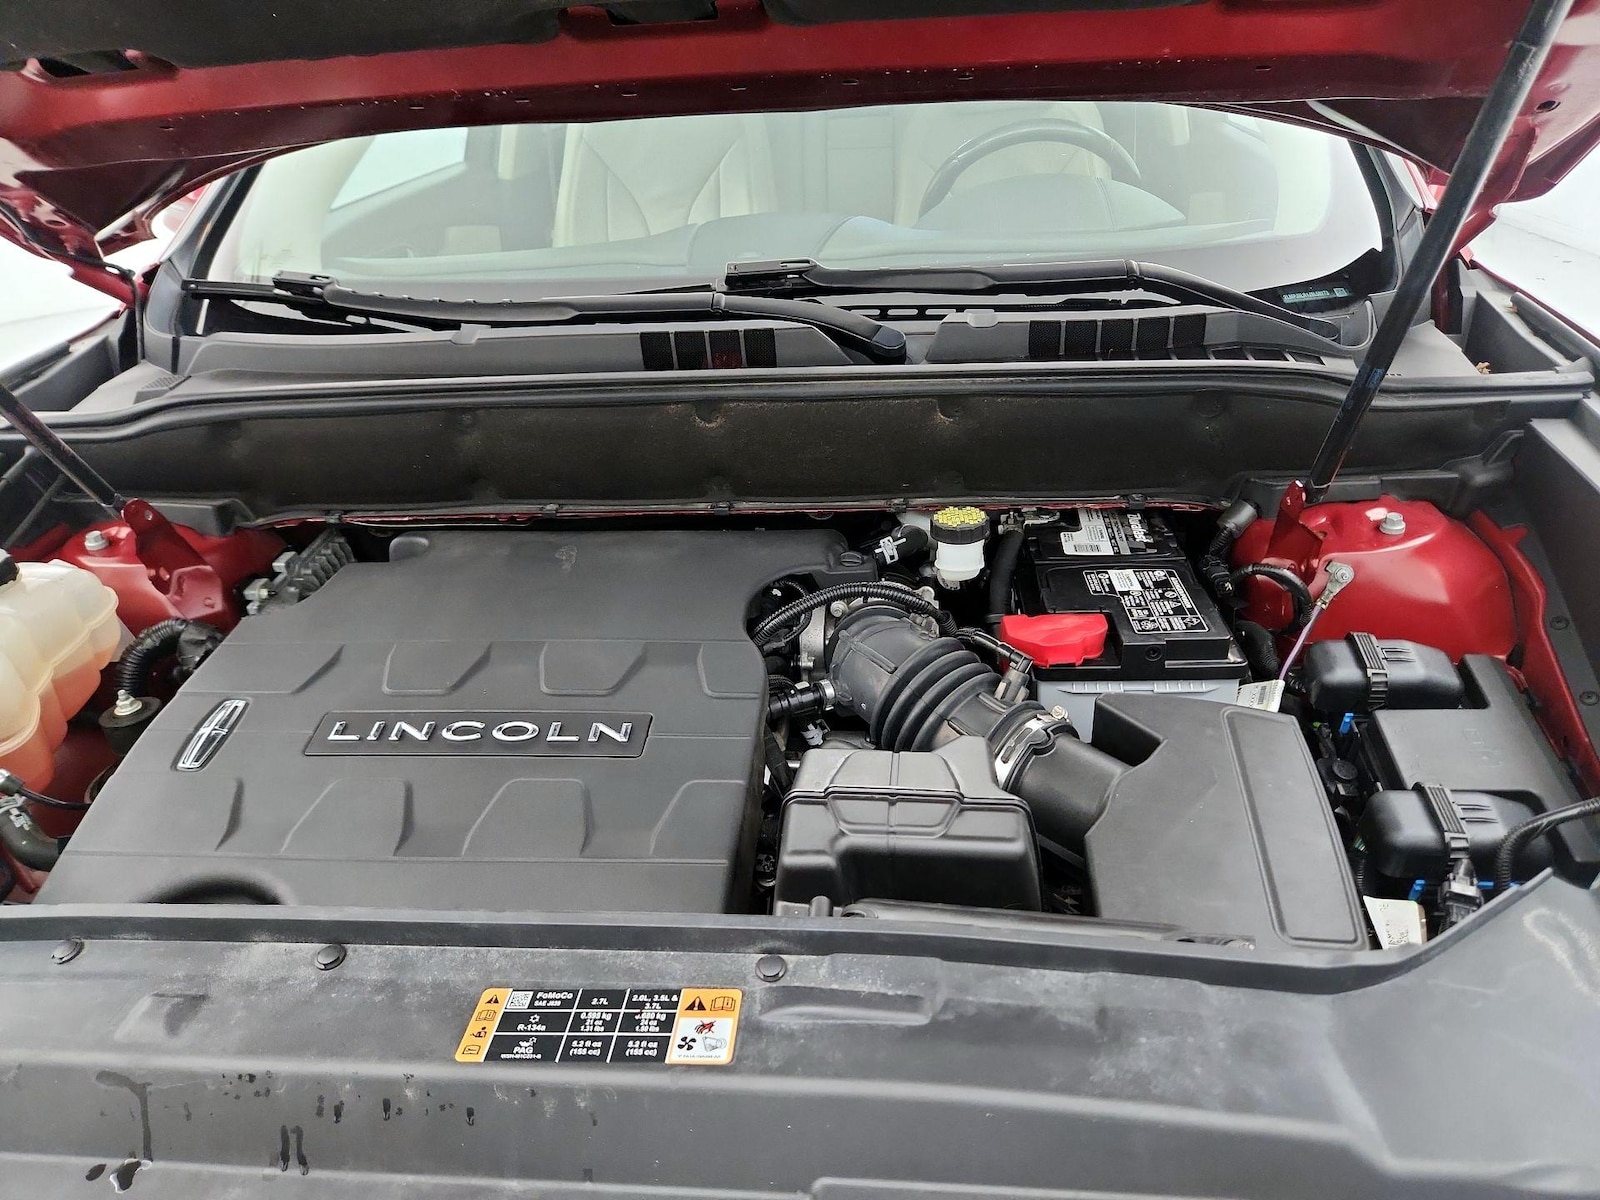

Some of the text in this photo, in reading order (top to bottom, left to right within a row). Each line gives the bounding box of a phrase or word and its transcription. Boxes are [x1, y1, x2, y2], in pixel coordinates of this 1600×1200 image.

[1127, 513, 1154, 543] Duralast
[327, 721, 632, 742] LINCOLN
[601, 1011, 612, 1021] kg
[655, 1011, 667, 1021] kg
[513, 1046, 533, 1054] PAG
